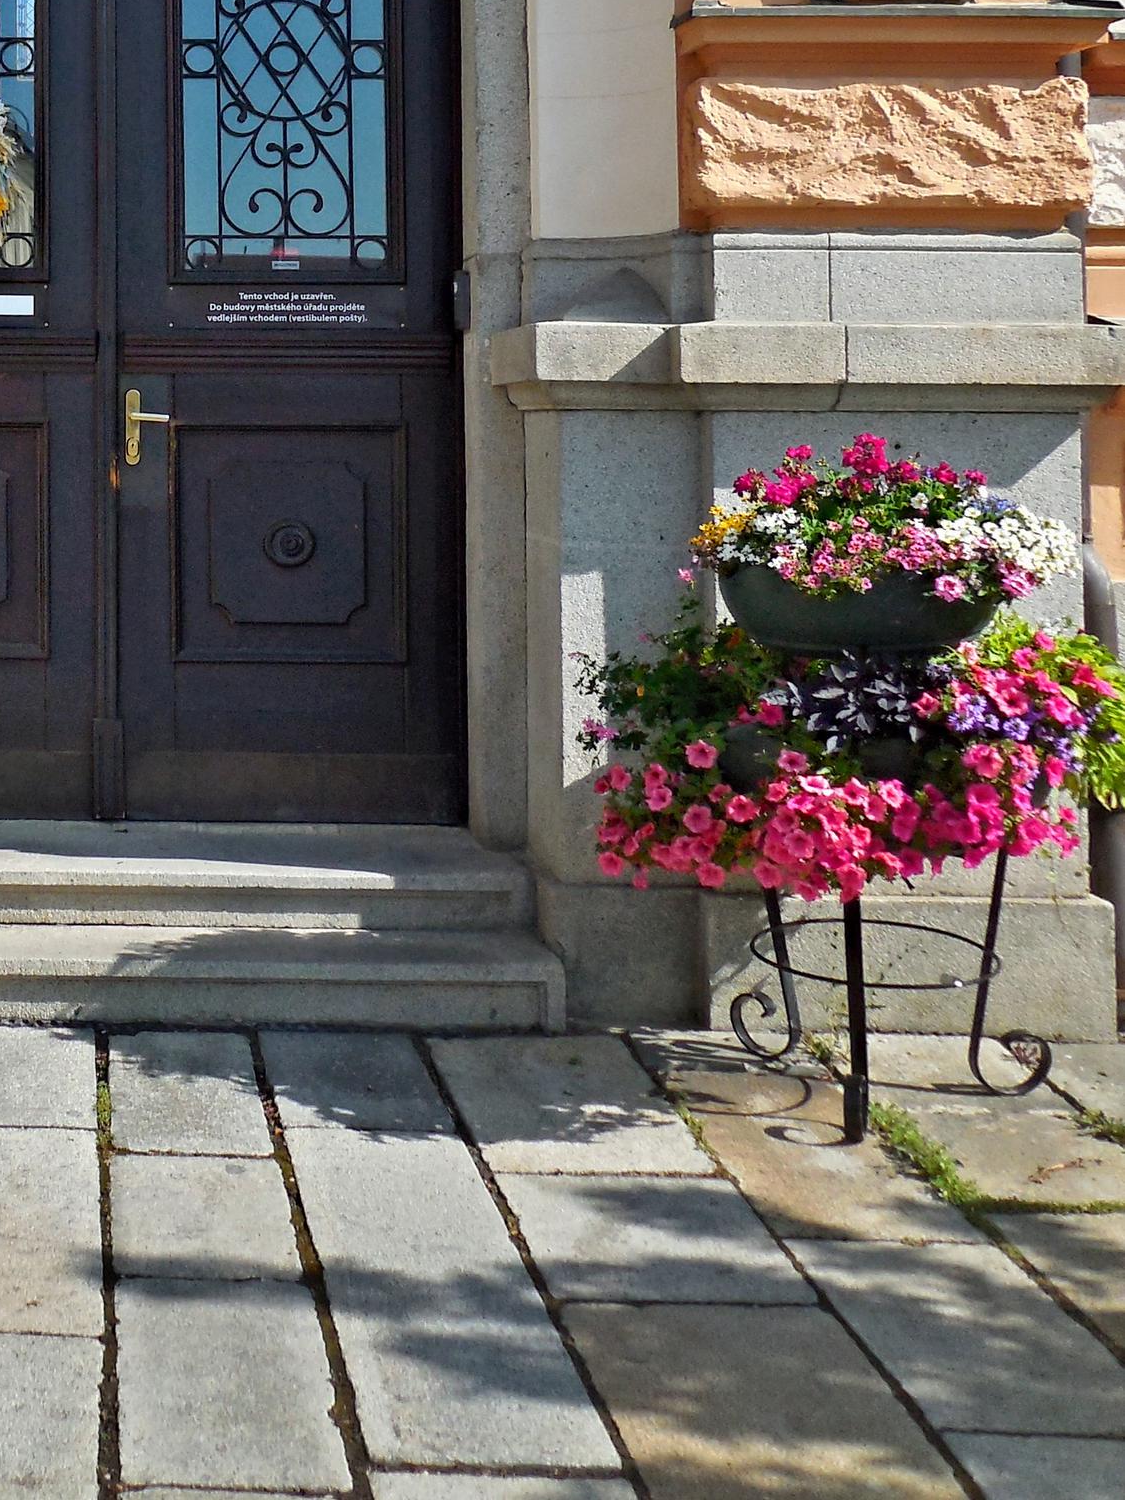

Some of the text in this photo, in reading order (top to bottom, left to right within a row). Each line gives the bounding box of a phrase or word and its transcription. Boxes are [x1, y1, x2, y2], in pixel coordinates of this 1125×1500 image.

[239, 292, 336, 301] Tento vchod je uzavřen.
[224, 303, 255, 312] budovy
[329, 303, 365, 312] projděte
[207, 314, 247, 323] vedlejším
[289, 314, 337, 322] (vestibulem
[339, 314, 367, 323] pošty).
